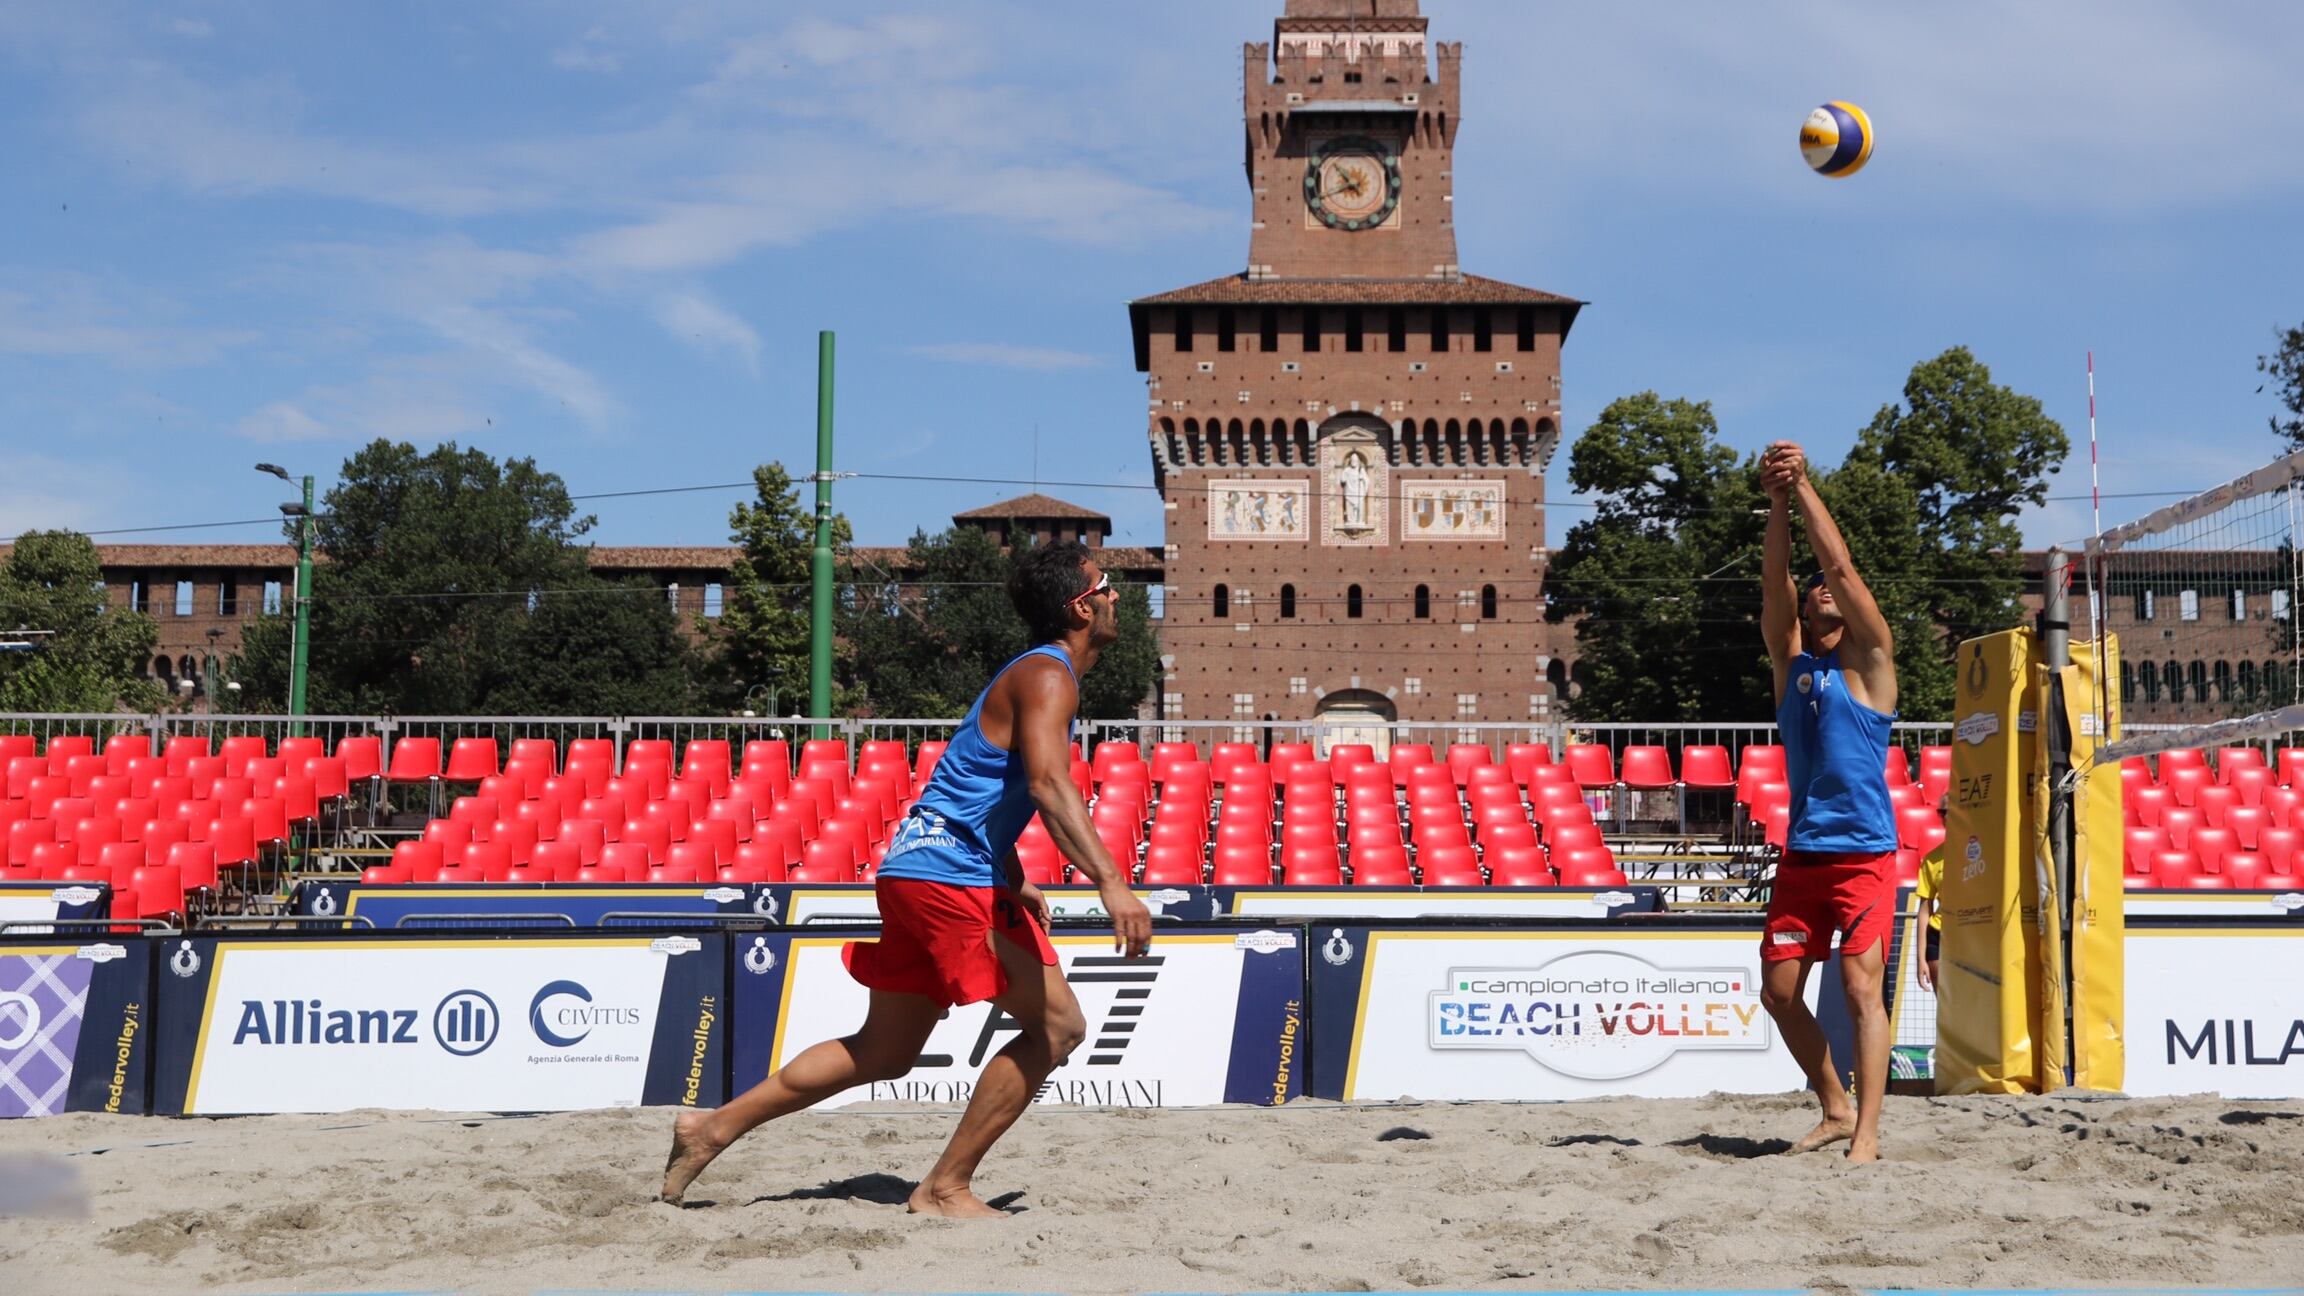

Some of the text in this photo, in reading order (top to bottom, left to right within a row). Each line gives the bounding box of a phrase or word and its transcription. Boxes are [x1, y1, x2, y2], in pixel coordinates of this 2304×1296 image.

[1471, 978, 1729, 996] campionato italiano
[233, 999, 418, 1045] Allianz
[558, 1006, 640, 1025] CIVITUS
[1440, 1002, 1759, 1036] BEACH VOLLEY
[105, 1002, 139, 1112] federvolley.it
[527, 1054, 640, 1064] Agenzia Generale di Roma
[682, 995, 715, 1106] federvolley.it
[1270, 1000, 1300, 1105] edervolley.it
[871, 1080, 1162, 1108] EMPOR ARMANI
